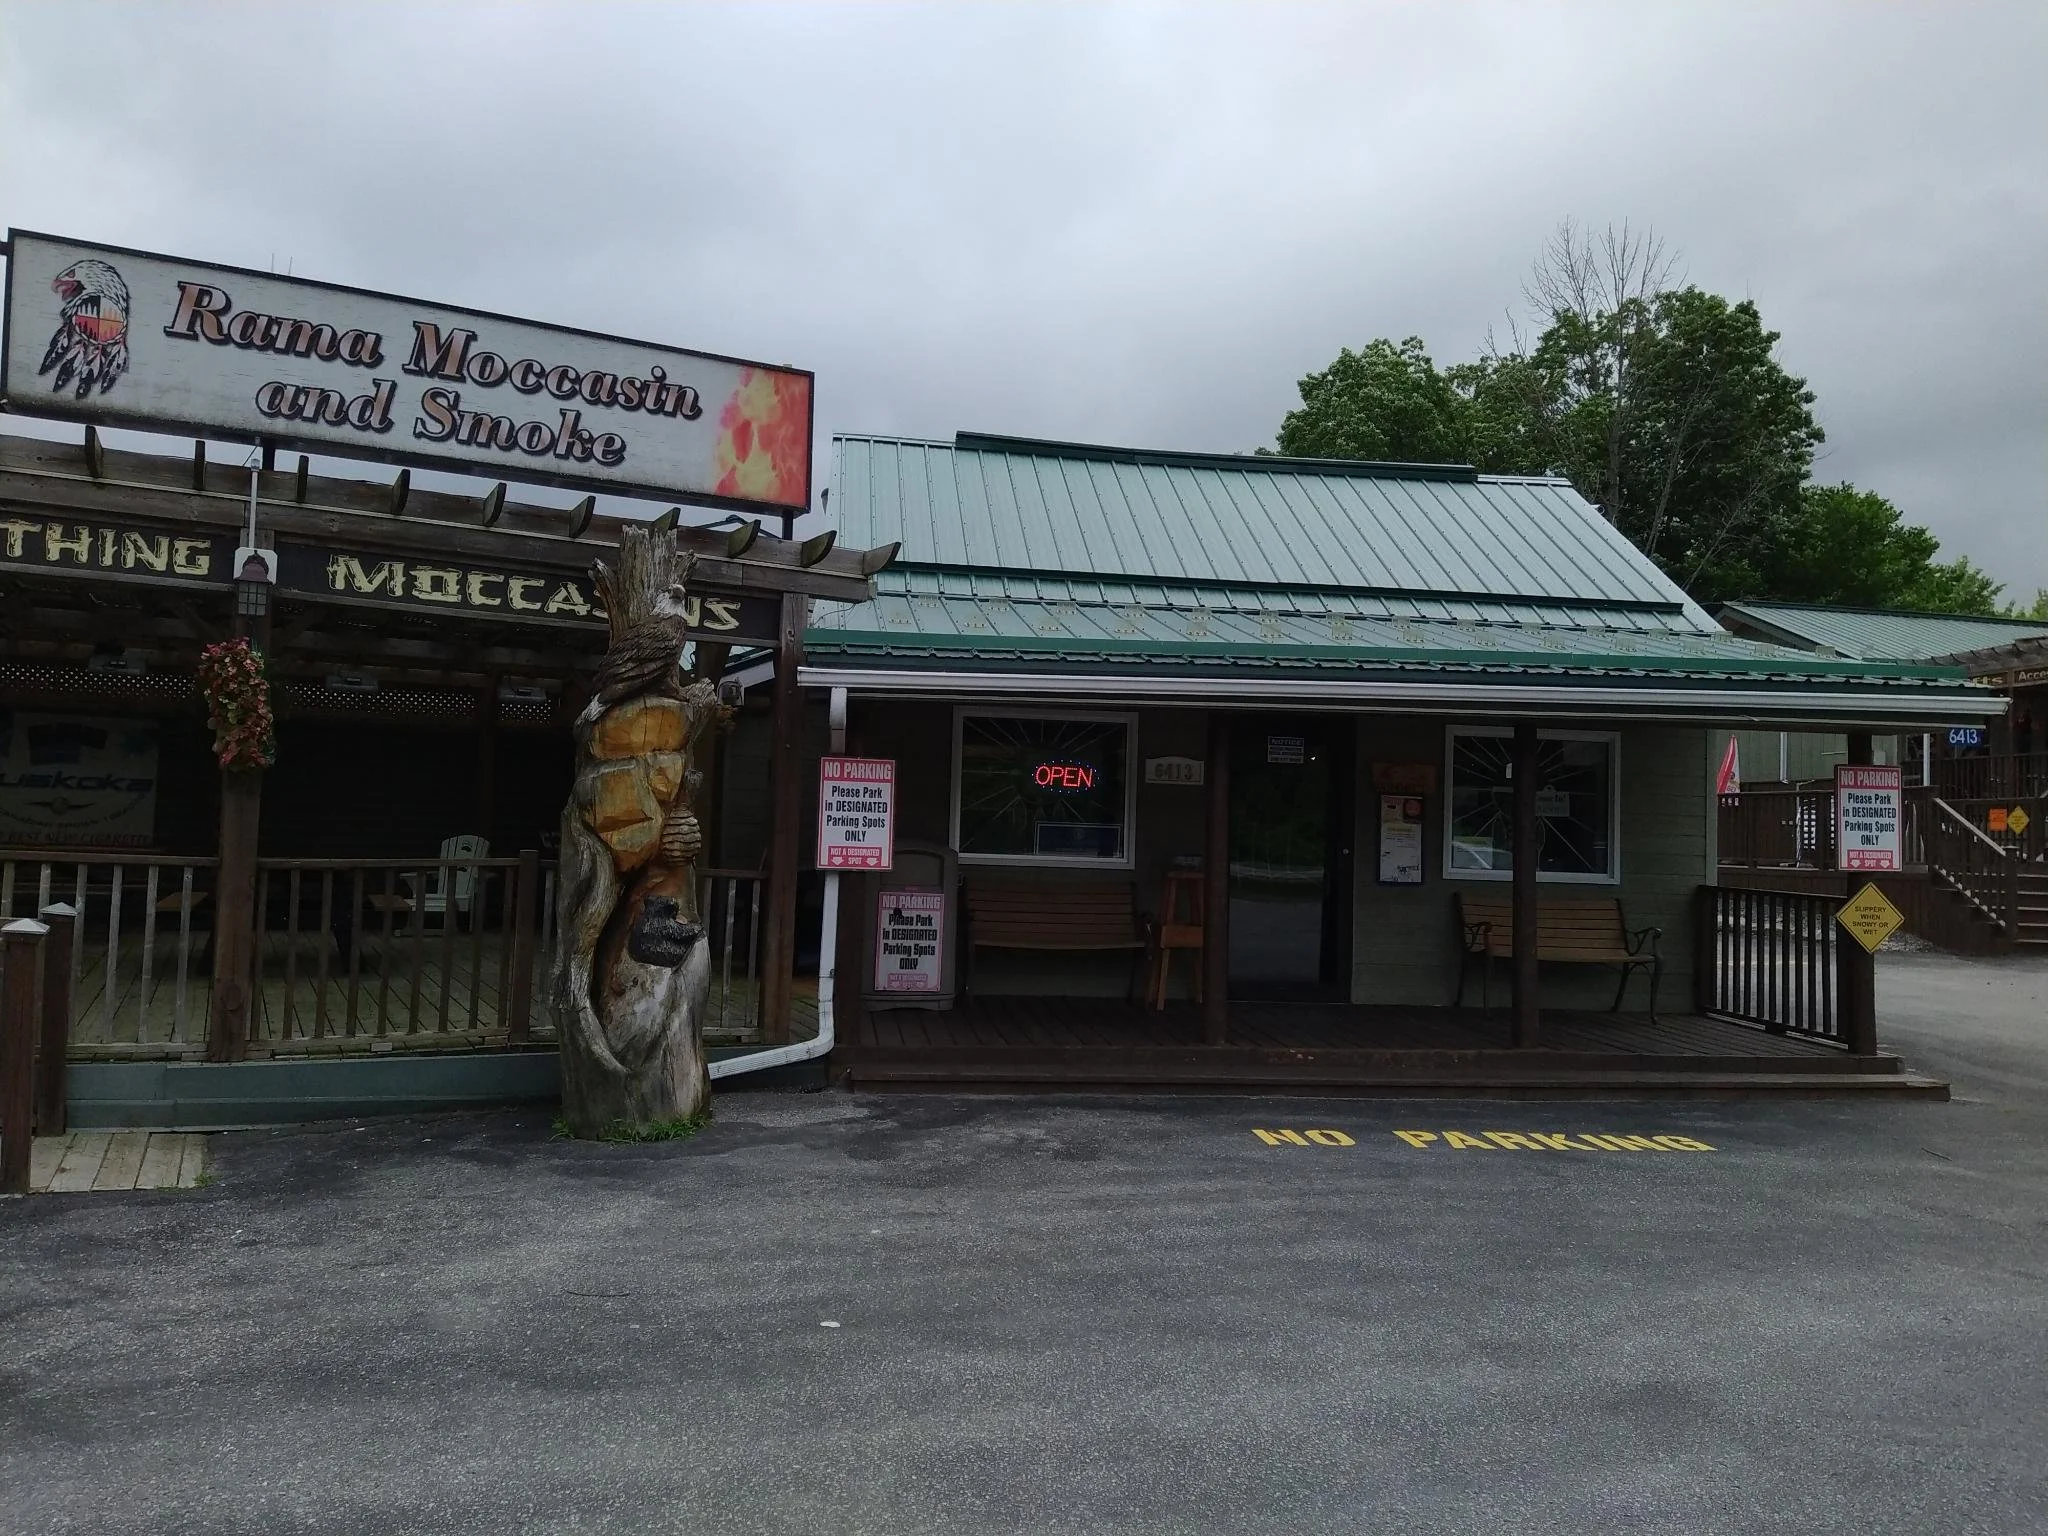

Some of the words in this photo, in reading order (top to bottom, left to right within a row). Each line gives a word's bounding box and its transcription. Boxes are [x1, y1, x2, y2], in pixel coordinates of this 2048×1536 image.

[163, 281, 384, 367] Rama
[402, 320, 703, 420] Moccasin
[256, 378, 396, 433] and
[413, 387, 626, 465] Smoke
[0, 519, 211, 575] THING
[328, 554, 741, 630] MOCCAS
[2018, 671, 2048, 681] Acce
[1949, 729, 1978, 744] 6413
[825, 761, 840, 777] NO
[844, 762, 892, 780] PARKING
[1035, 765, 1093, 788] OPEN
[1841, 771, 1854, 785] NO
[1857, 771, 1898, 787] PARKING
[832, 786, 860, 797] Please
[863, 787, 882, 799] Park
[1848, 793, 1872, 804] Please
[1875, 794, 1891, 805] Park
[825, 800, 833, 812] in
[836, 801, 888, 813] DESIGNATED
[1843, 807, 1850, 817] in
[1852, 807, 1897, 818] DESIGNATED
[826, 815, 859, 828] Parking
[862, 816, 885, 829] Spots
[1844, 821, 1873, 833] Parking
[1875, 821, 1895, 833] Spots
[845, 831, 866, 842] ONLY
[1861, 835, 1879, 846] ONLY
[883, 895, 897, 908] NO
[900, 896, 941, 909] PARKING
[916, 915, 933, 926] Park
[883, 929, 890, 940] in
[892, 930, 937, 941] DESIGNATED
[883, 943, 911, 957] Parking
[914, 944, 935, 957] Spots
[900, 958, 918, 969] ONLY
[1251, 1129, 1357, 1147] NO
[1392, 1131, 1719, 1151] PARKING
